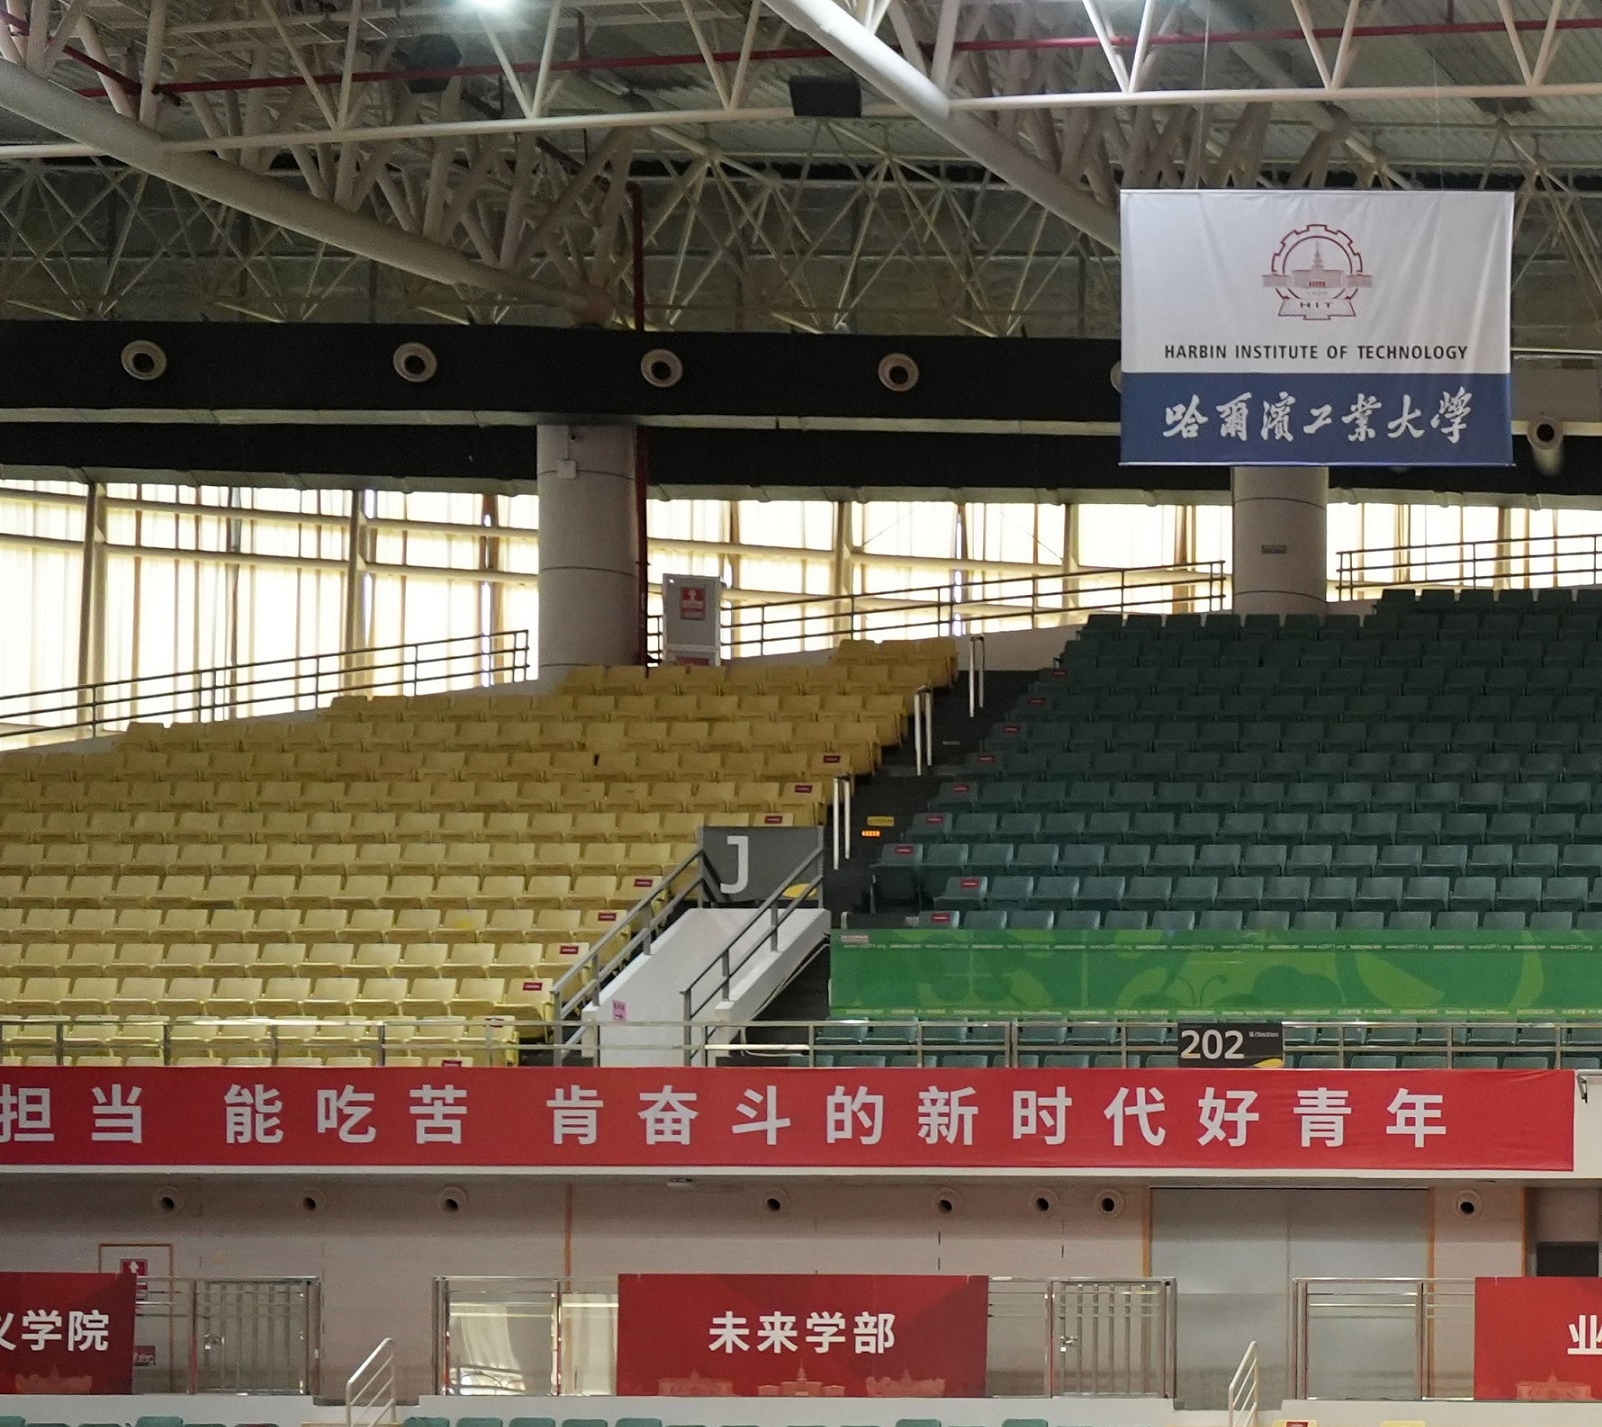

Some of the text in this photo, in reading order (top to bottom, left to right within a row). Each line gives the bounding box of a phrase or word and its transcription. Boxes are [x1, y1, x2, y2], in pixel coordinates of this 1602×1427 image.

[1164, 345, 1469, 360] HARBIN INSTITUTE OF TECHNOLOGY
[720, 835, 749, 894] J
[1181, 1029, 1245, 1059] 202
[0, 1083, 1447, 1149] 担当 能吃苦 肯奋斗的新时代好青年
[708, 1310, 896, 1355] 未来学部
